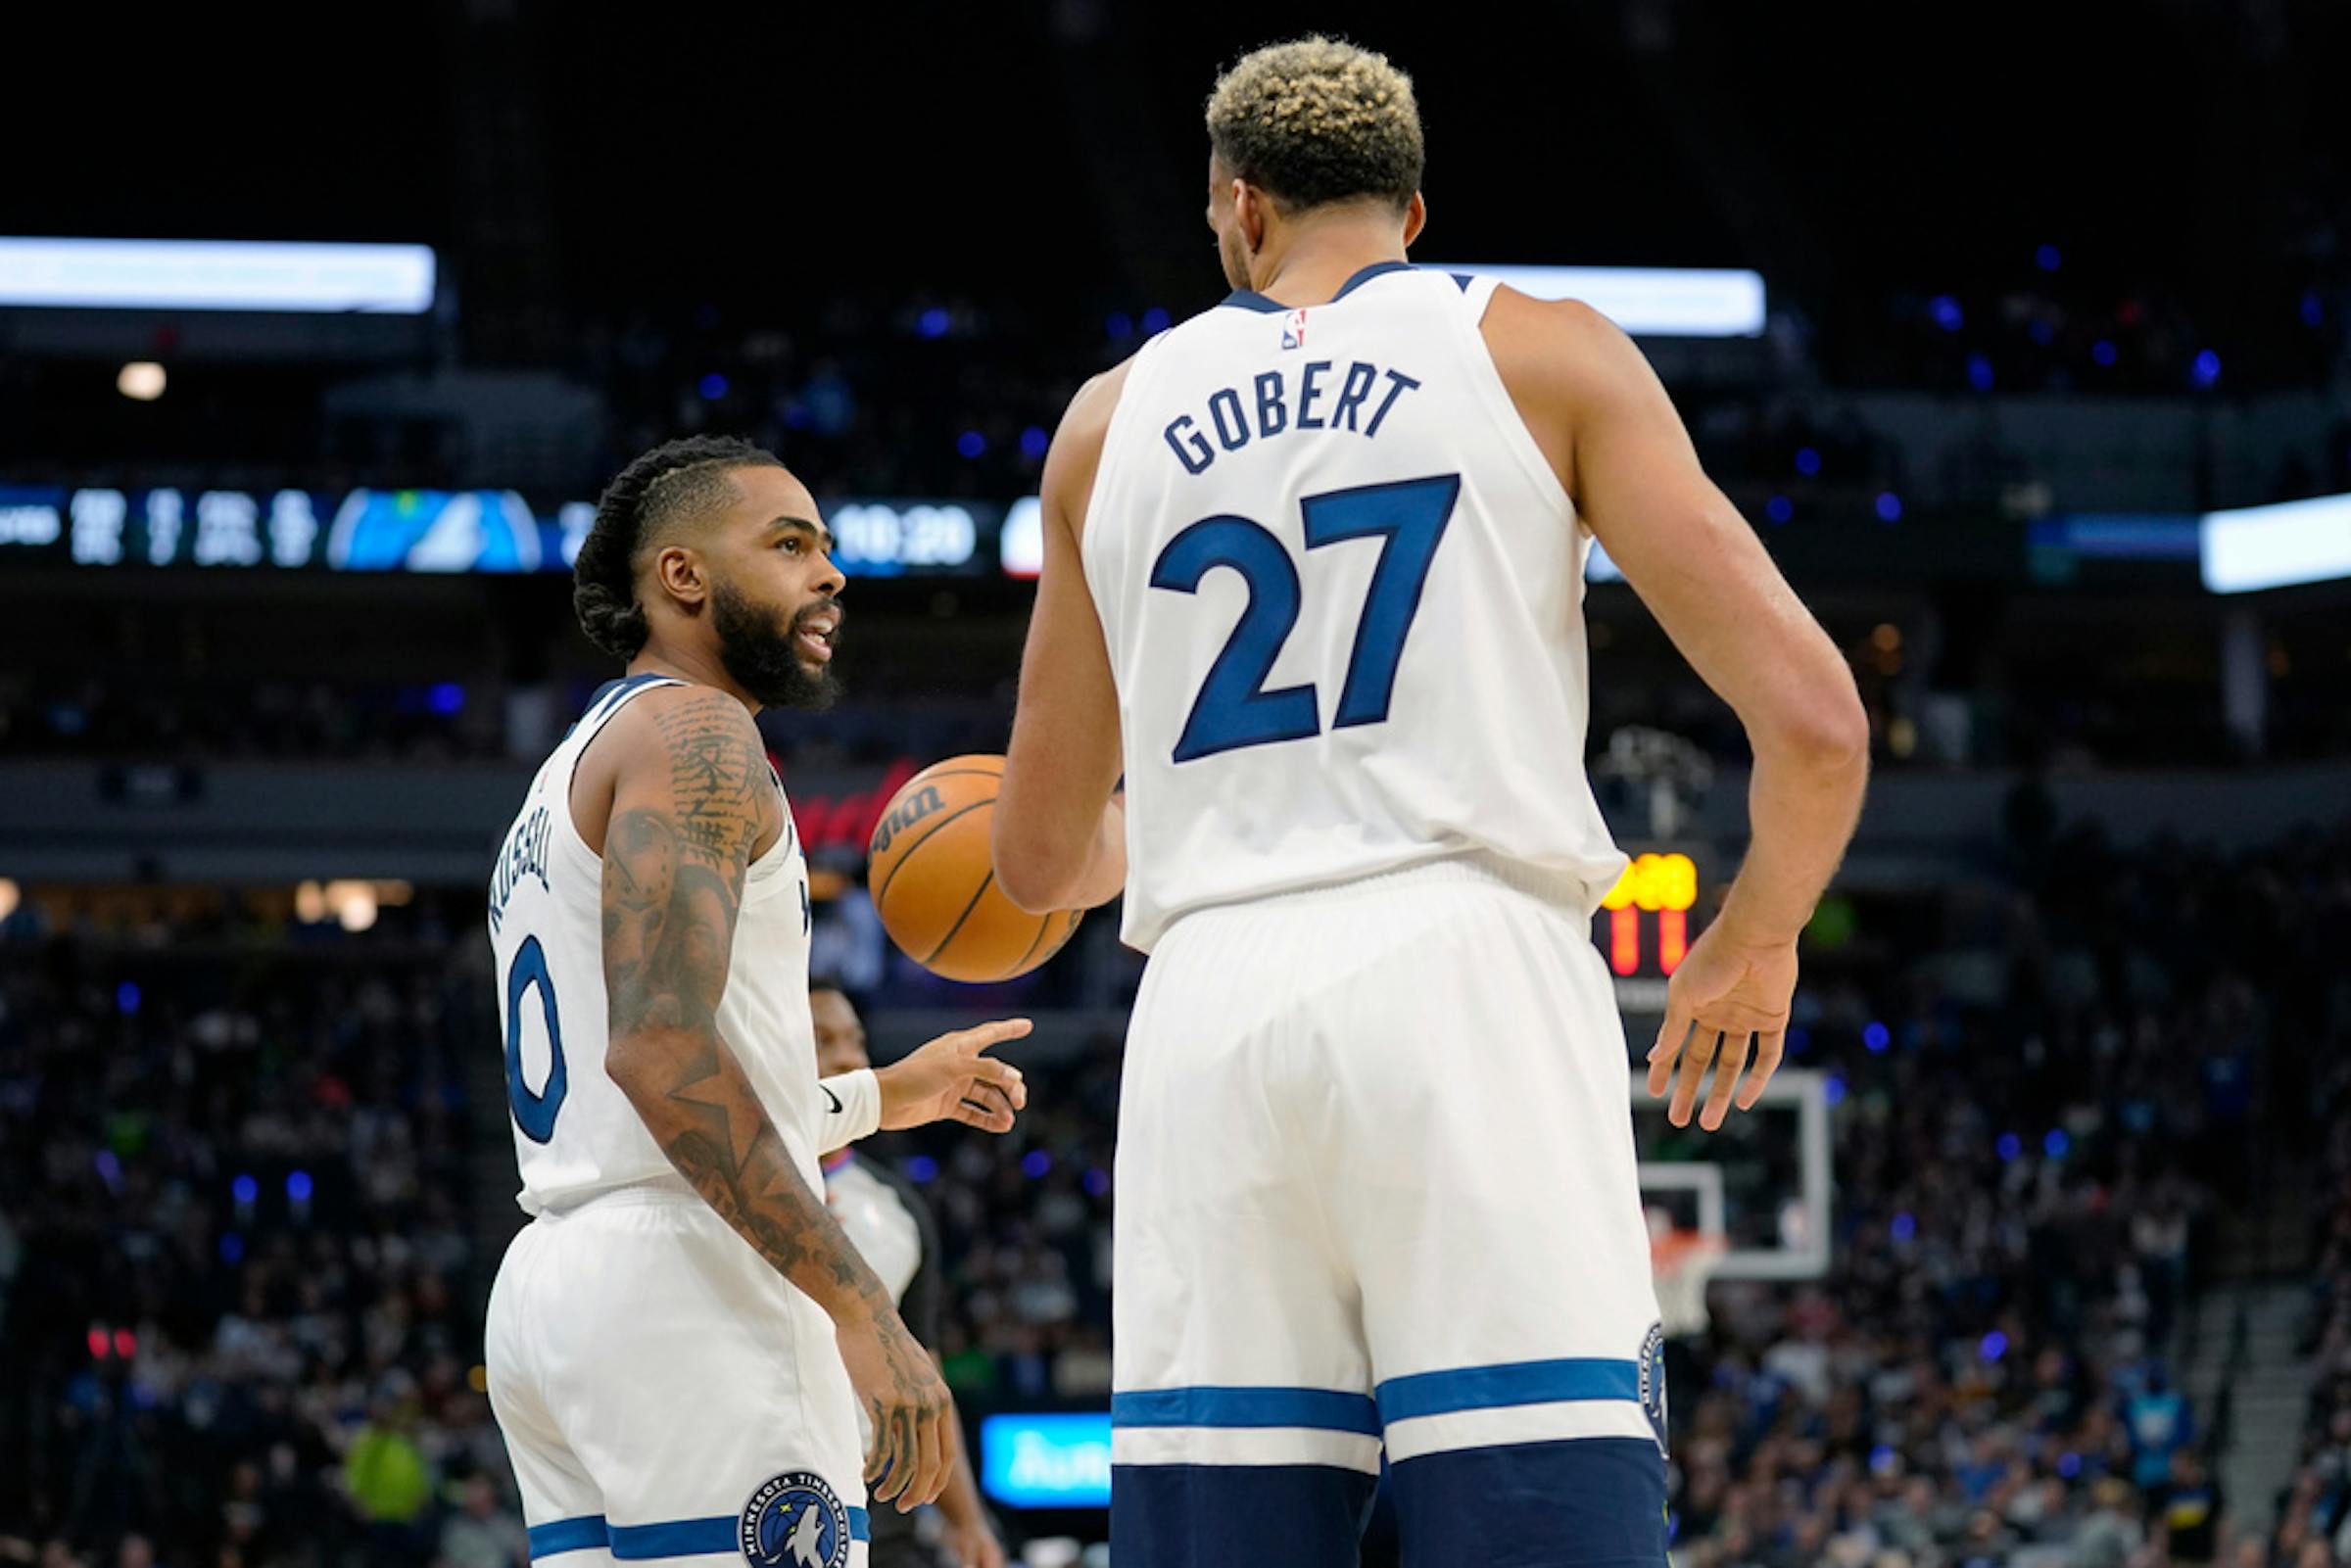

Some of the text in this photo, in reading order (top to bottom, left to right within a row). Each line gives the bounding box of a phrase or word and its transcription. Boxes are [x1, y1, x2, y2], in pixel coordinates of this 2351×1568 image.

[1164, 360, 1421, 475] GOBERT
[1148, 472, 1461, 765] 27
[506, 934, 569, 1146] 0
[744, 1477, 792, 1556] MINNESOTA
